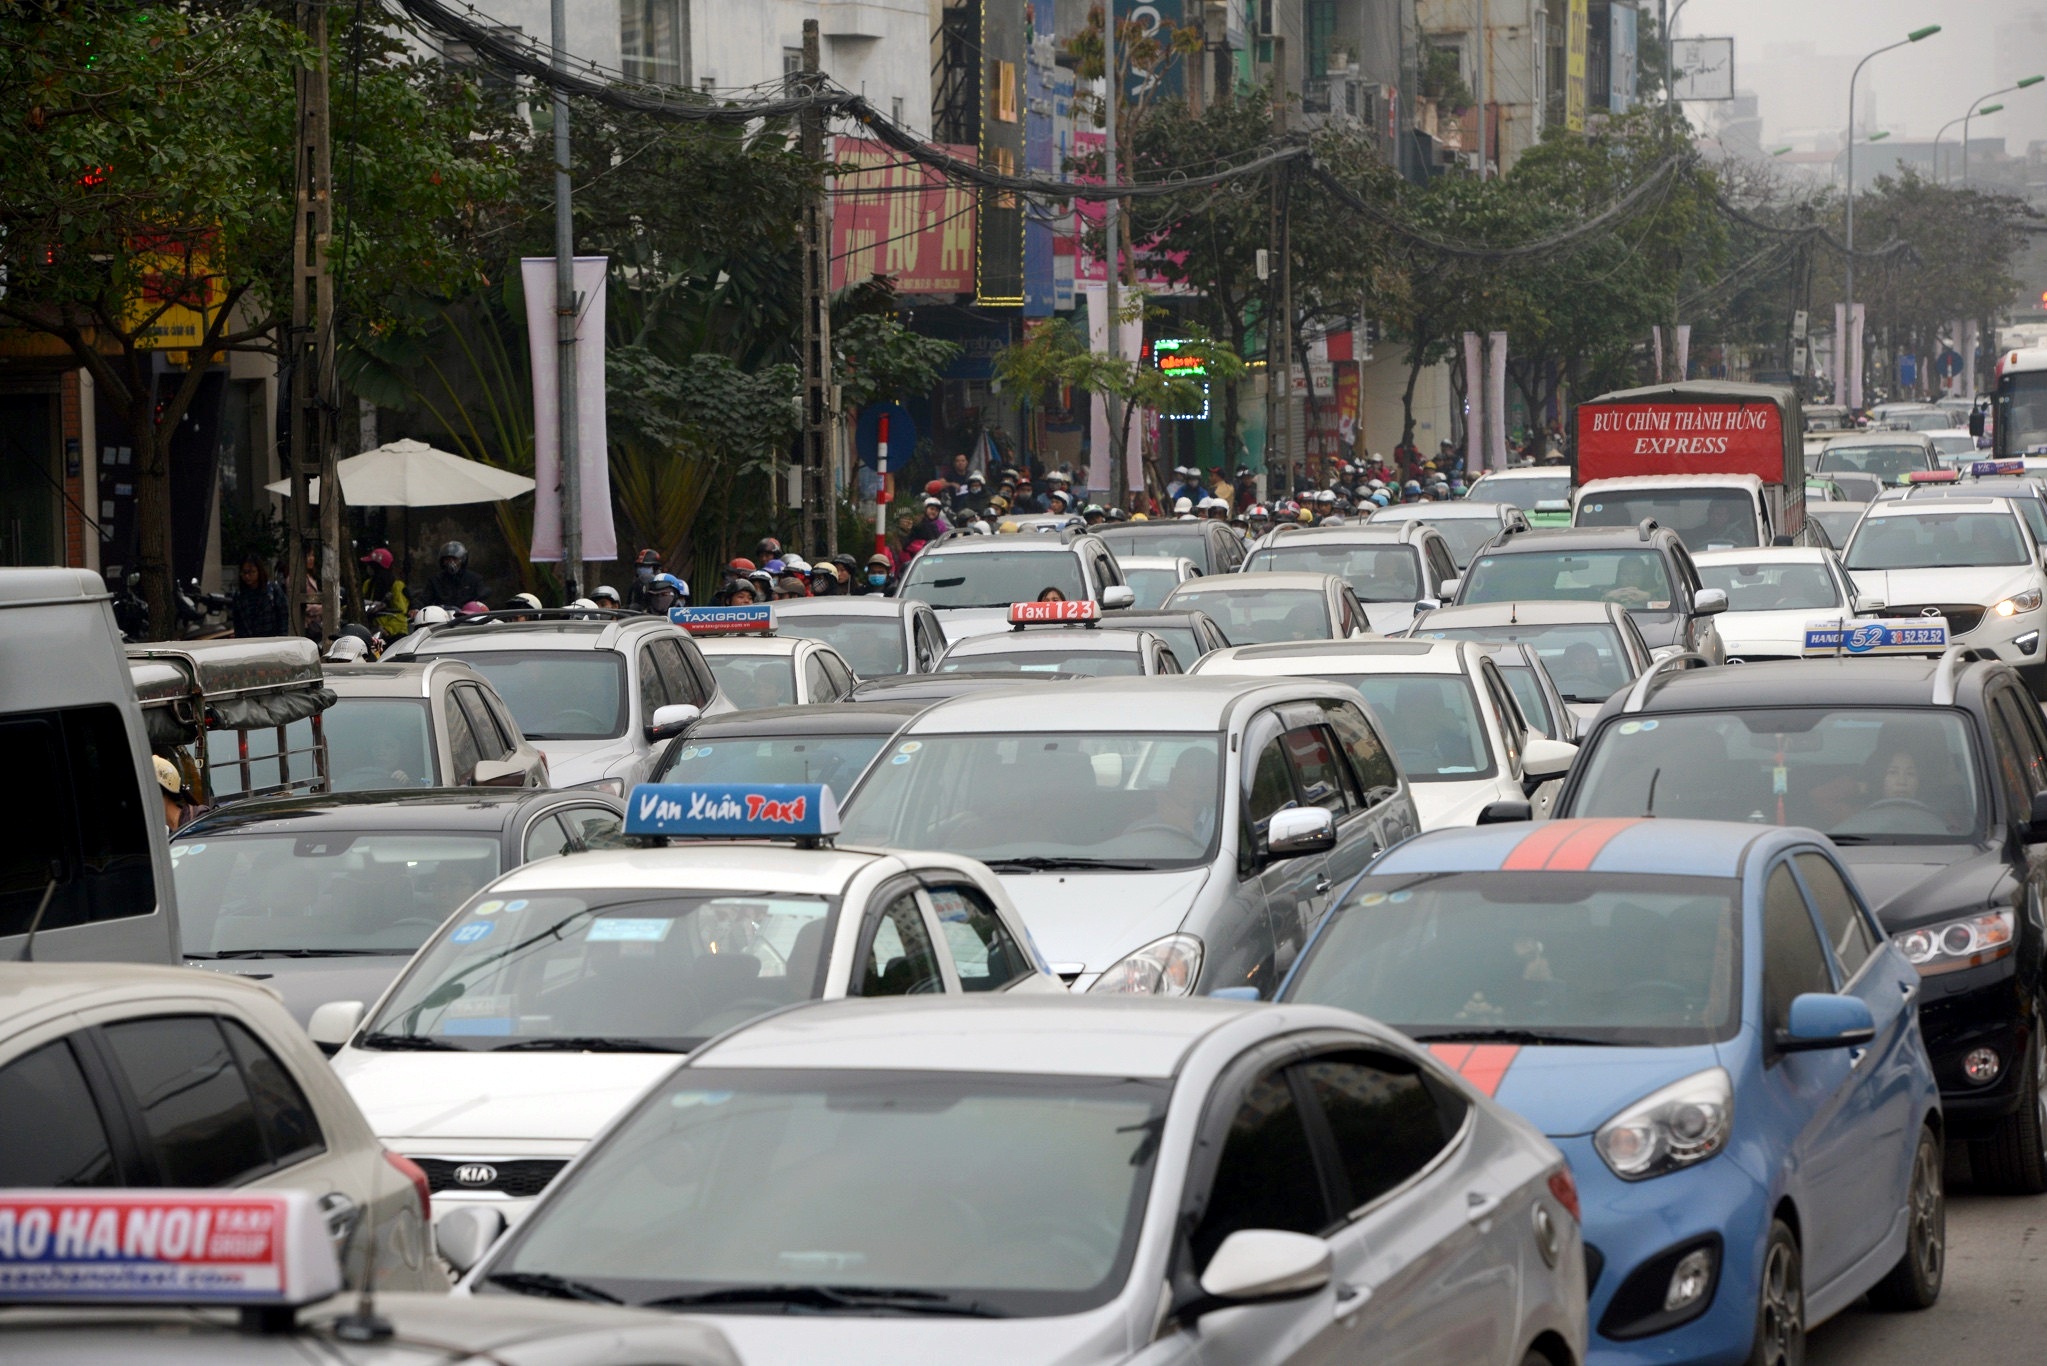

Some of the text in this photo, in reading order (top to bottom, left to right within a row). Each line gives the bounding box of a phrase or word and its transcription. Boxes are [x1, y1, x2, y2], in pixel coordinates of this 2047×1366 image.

[1593, 410, 1623, 431] BƯU
[1625, 407, 1671, 431] CHÍNH
[1675, 407, 1723, 431] THÀNH
[1634, 437, 1728, 454] EXPRESS
[683, 612, 768, 622] TAXIGROUP
[1014, 602, 1050, 619] Taxi
[1810, 628, 1942, 647] HANOI 52 38.52.52.52
[639, 791, 807, 827] Vạn Xuân Taxi
[455, 924, 490, 941] 121
[460, 1167, 488, 1181] KIA
